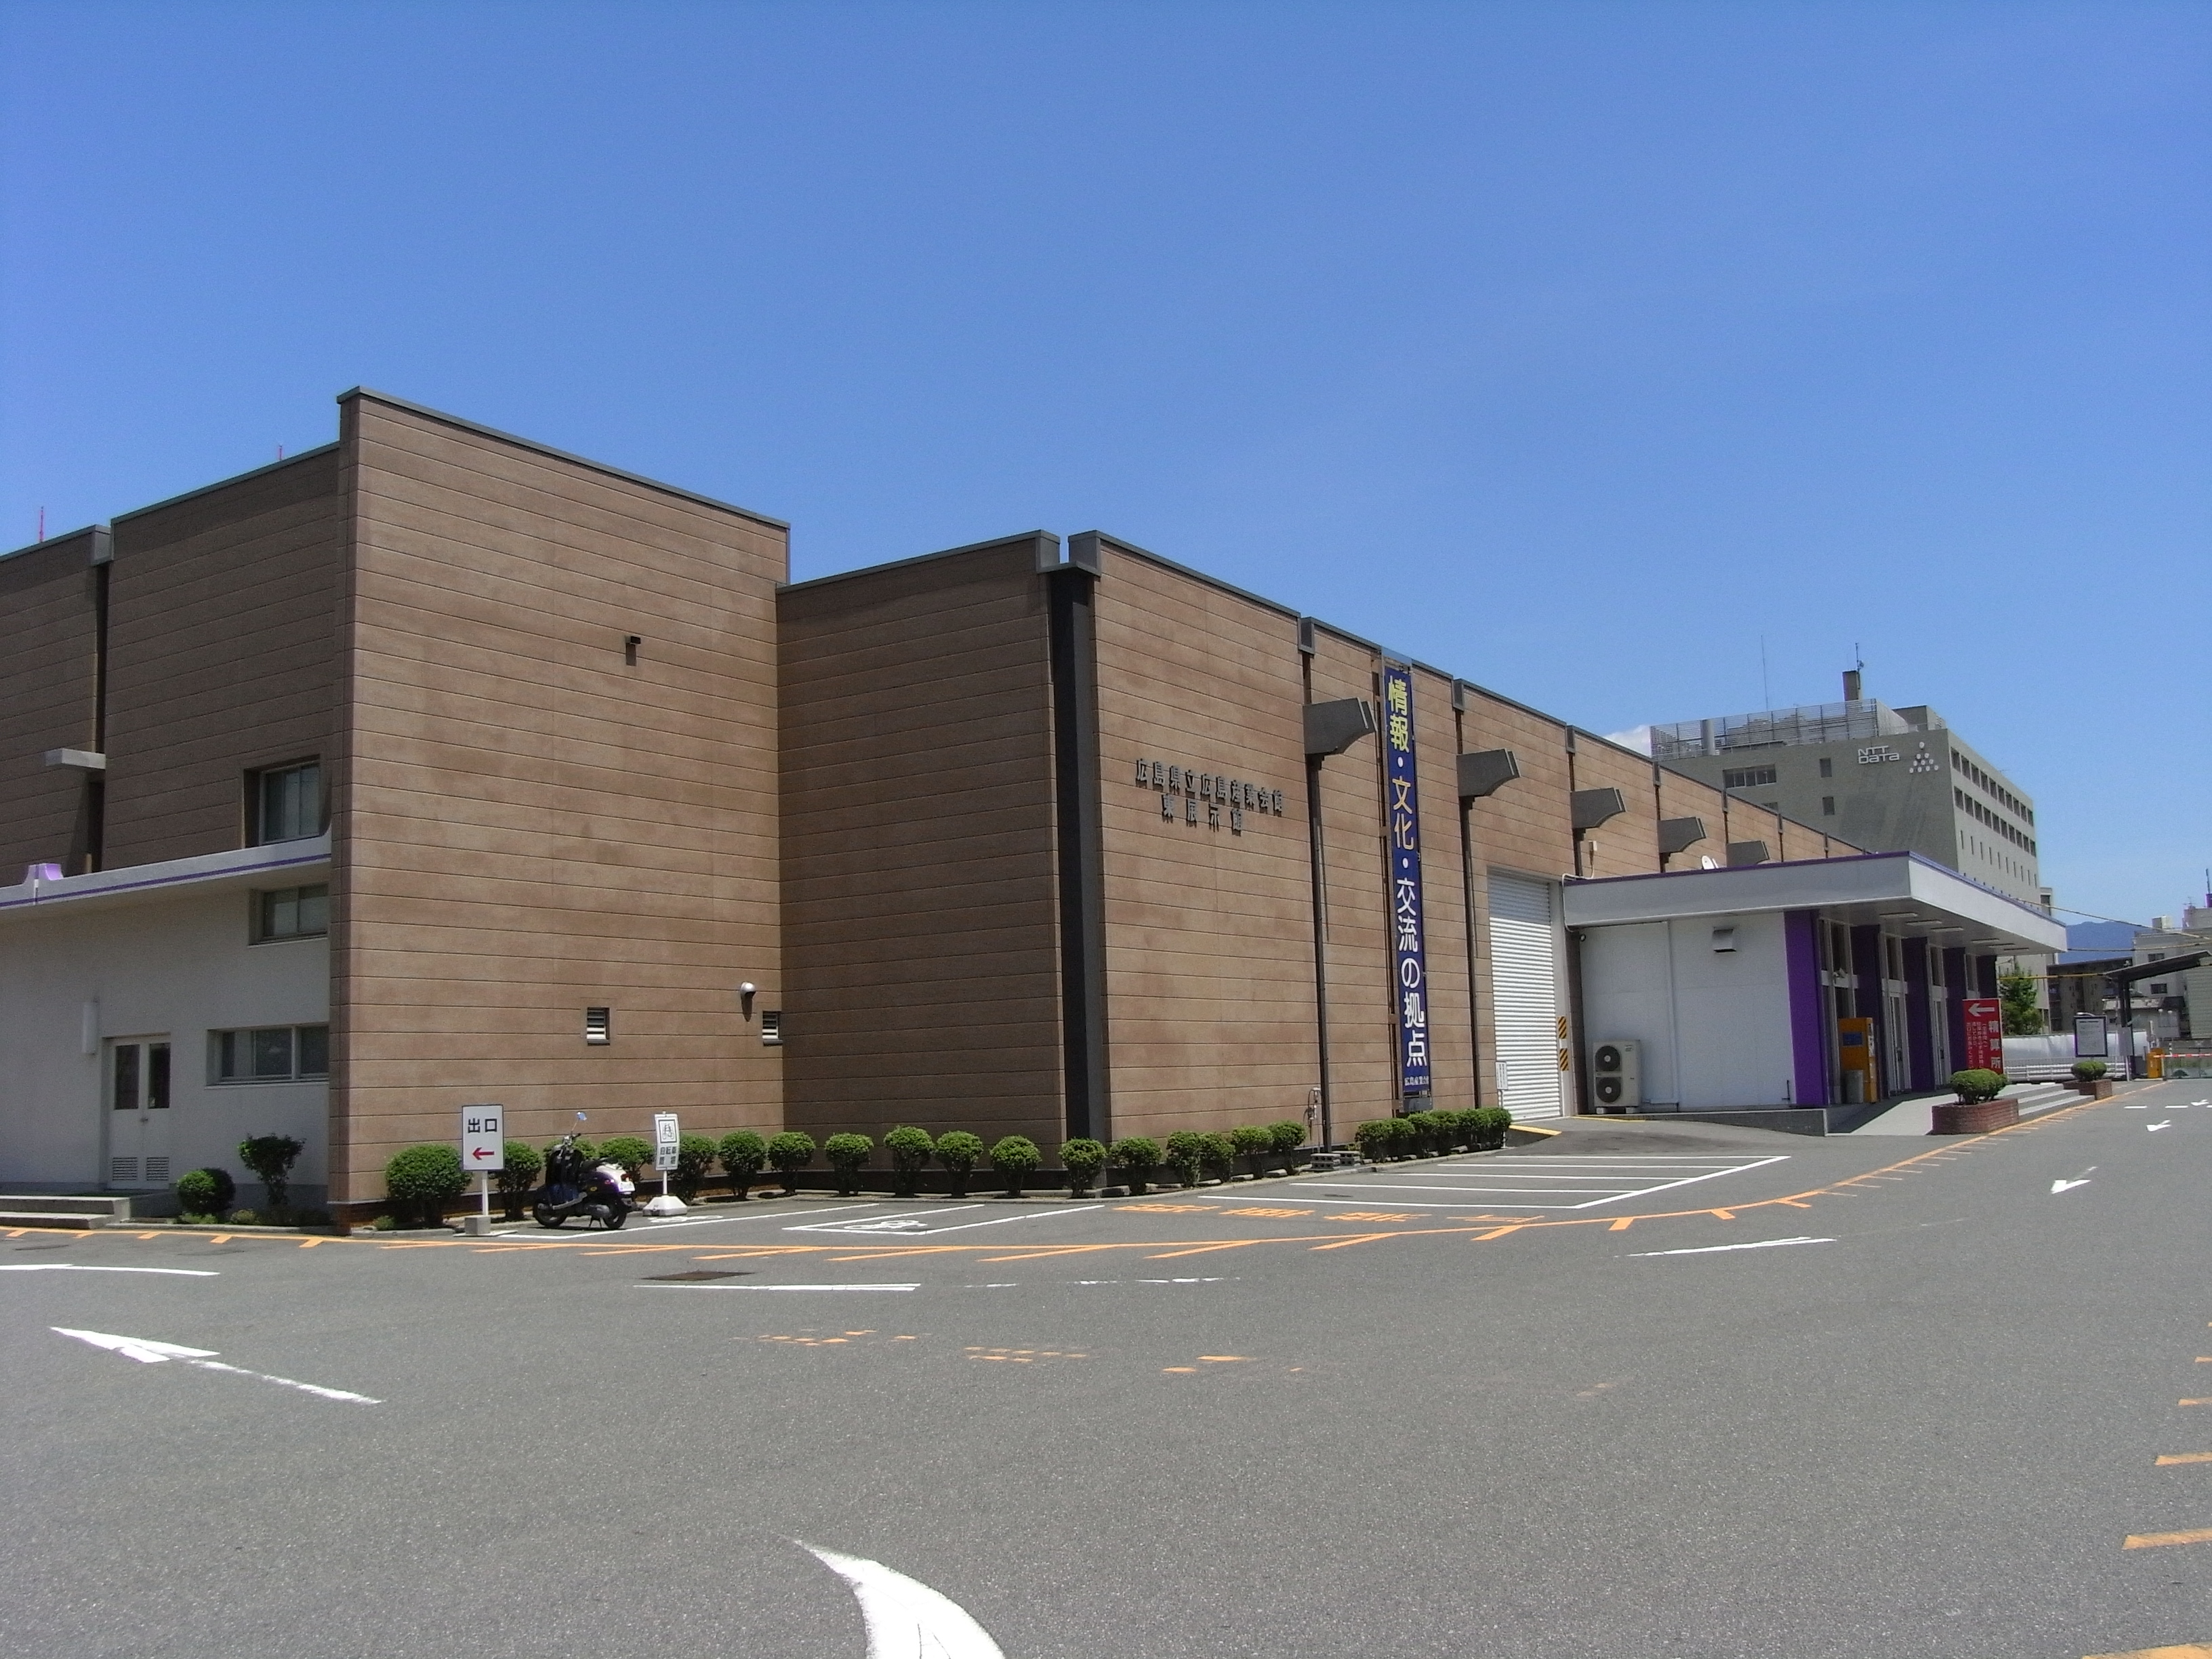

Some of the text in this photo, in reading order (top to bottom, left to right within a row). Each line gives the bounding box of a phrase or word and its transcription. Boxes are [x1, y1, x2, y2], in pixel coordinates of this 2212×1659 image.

[1858, 745, 1889, 756] NTT
[1136, 758, 1284, 814] 広島県立広島産業会館
[1161, 793, 1242, 832] 東展示館
[1389, 675, 1427, 1067] 情報・文化・交流の拠点
[468, 1118, 497, 1133] 出口
